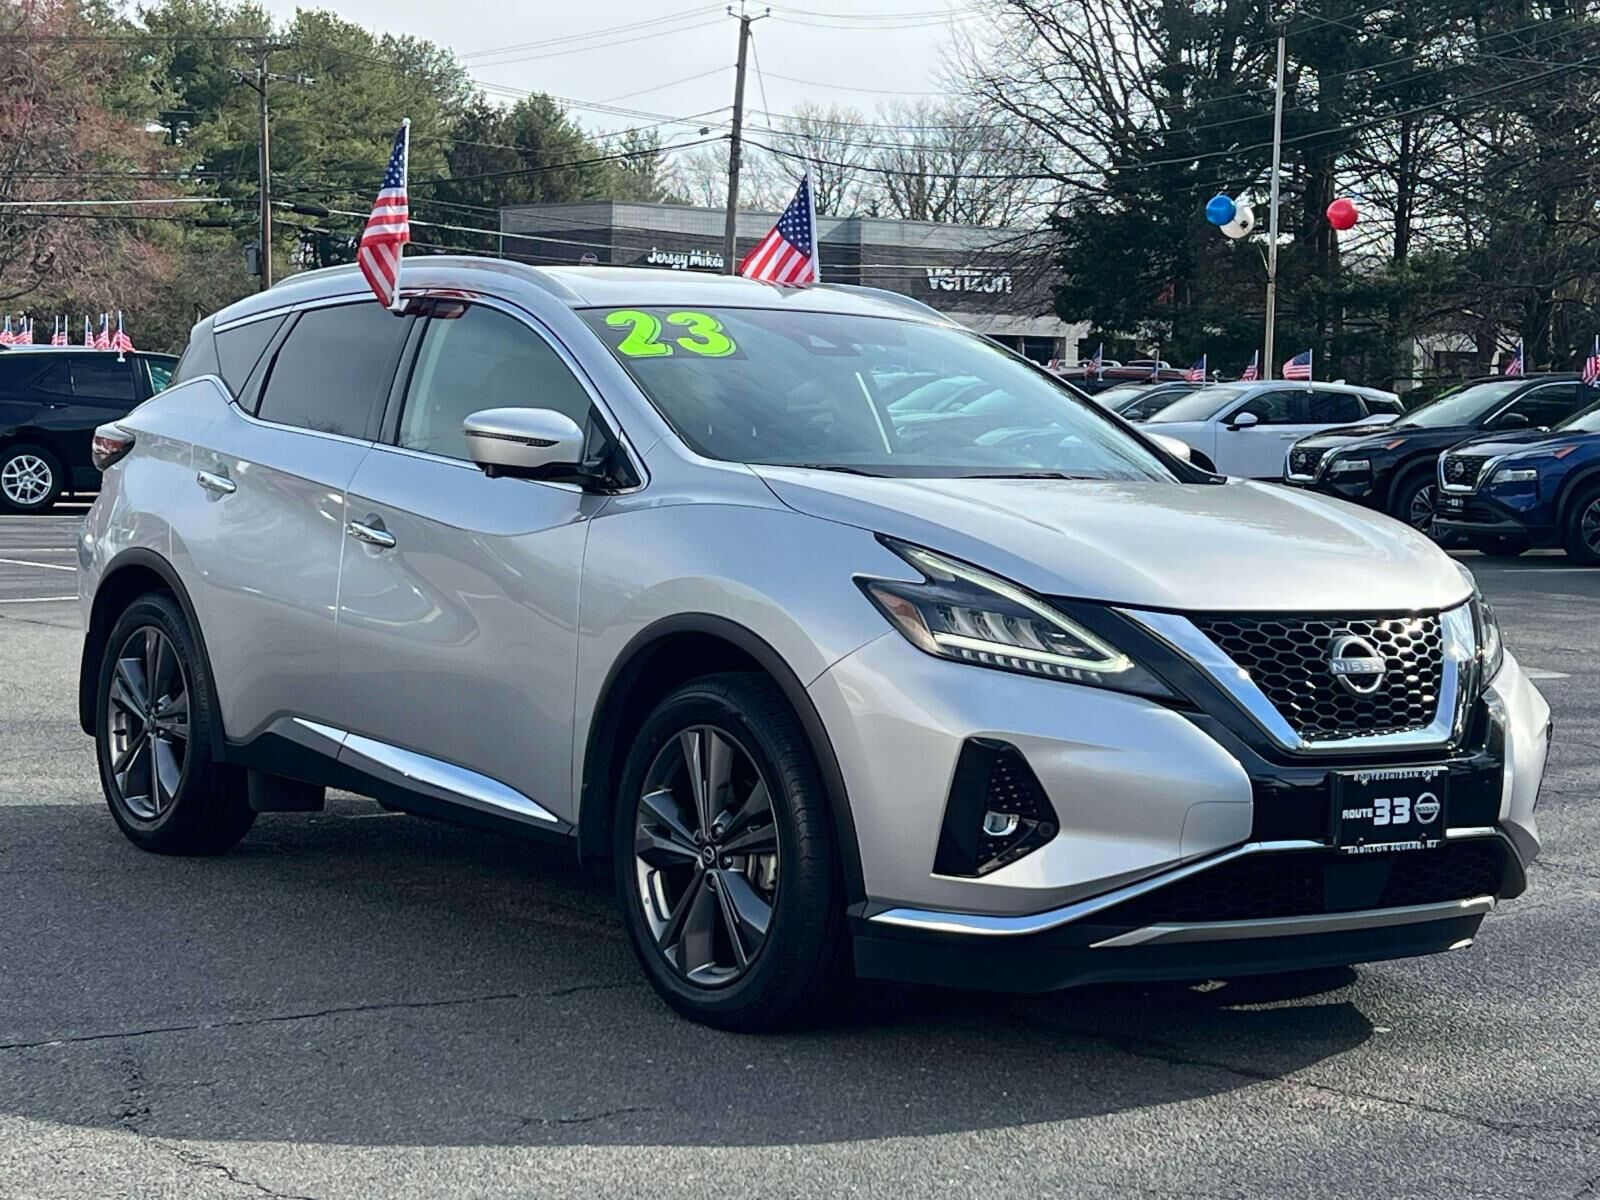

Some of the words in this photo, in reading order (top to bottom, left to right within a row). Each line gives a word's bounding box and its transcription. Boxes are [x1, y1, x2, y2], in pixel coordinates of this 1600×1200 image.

[647, 246, 688, 269] Jersey
[926, 267, 1012, 293] verizon
[605, 310, 737, 357] 23
[1342, 808, 1373, 819] ROUTE
[1373, 797, 1410, 825] 33
